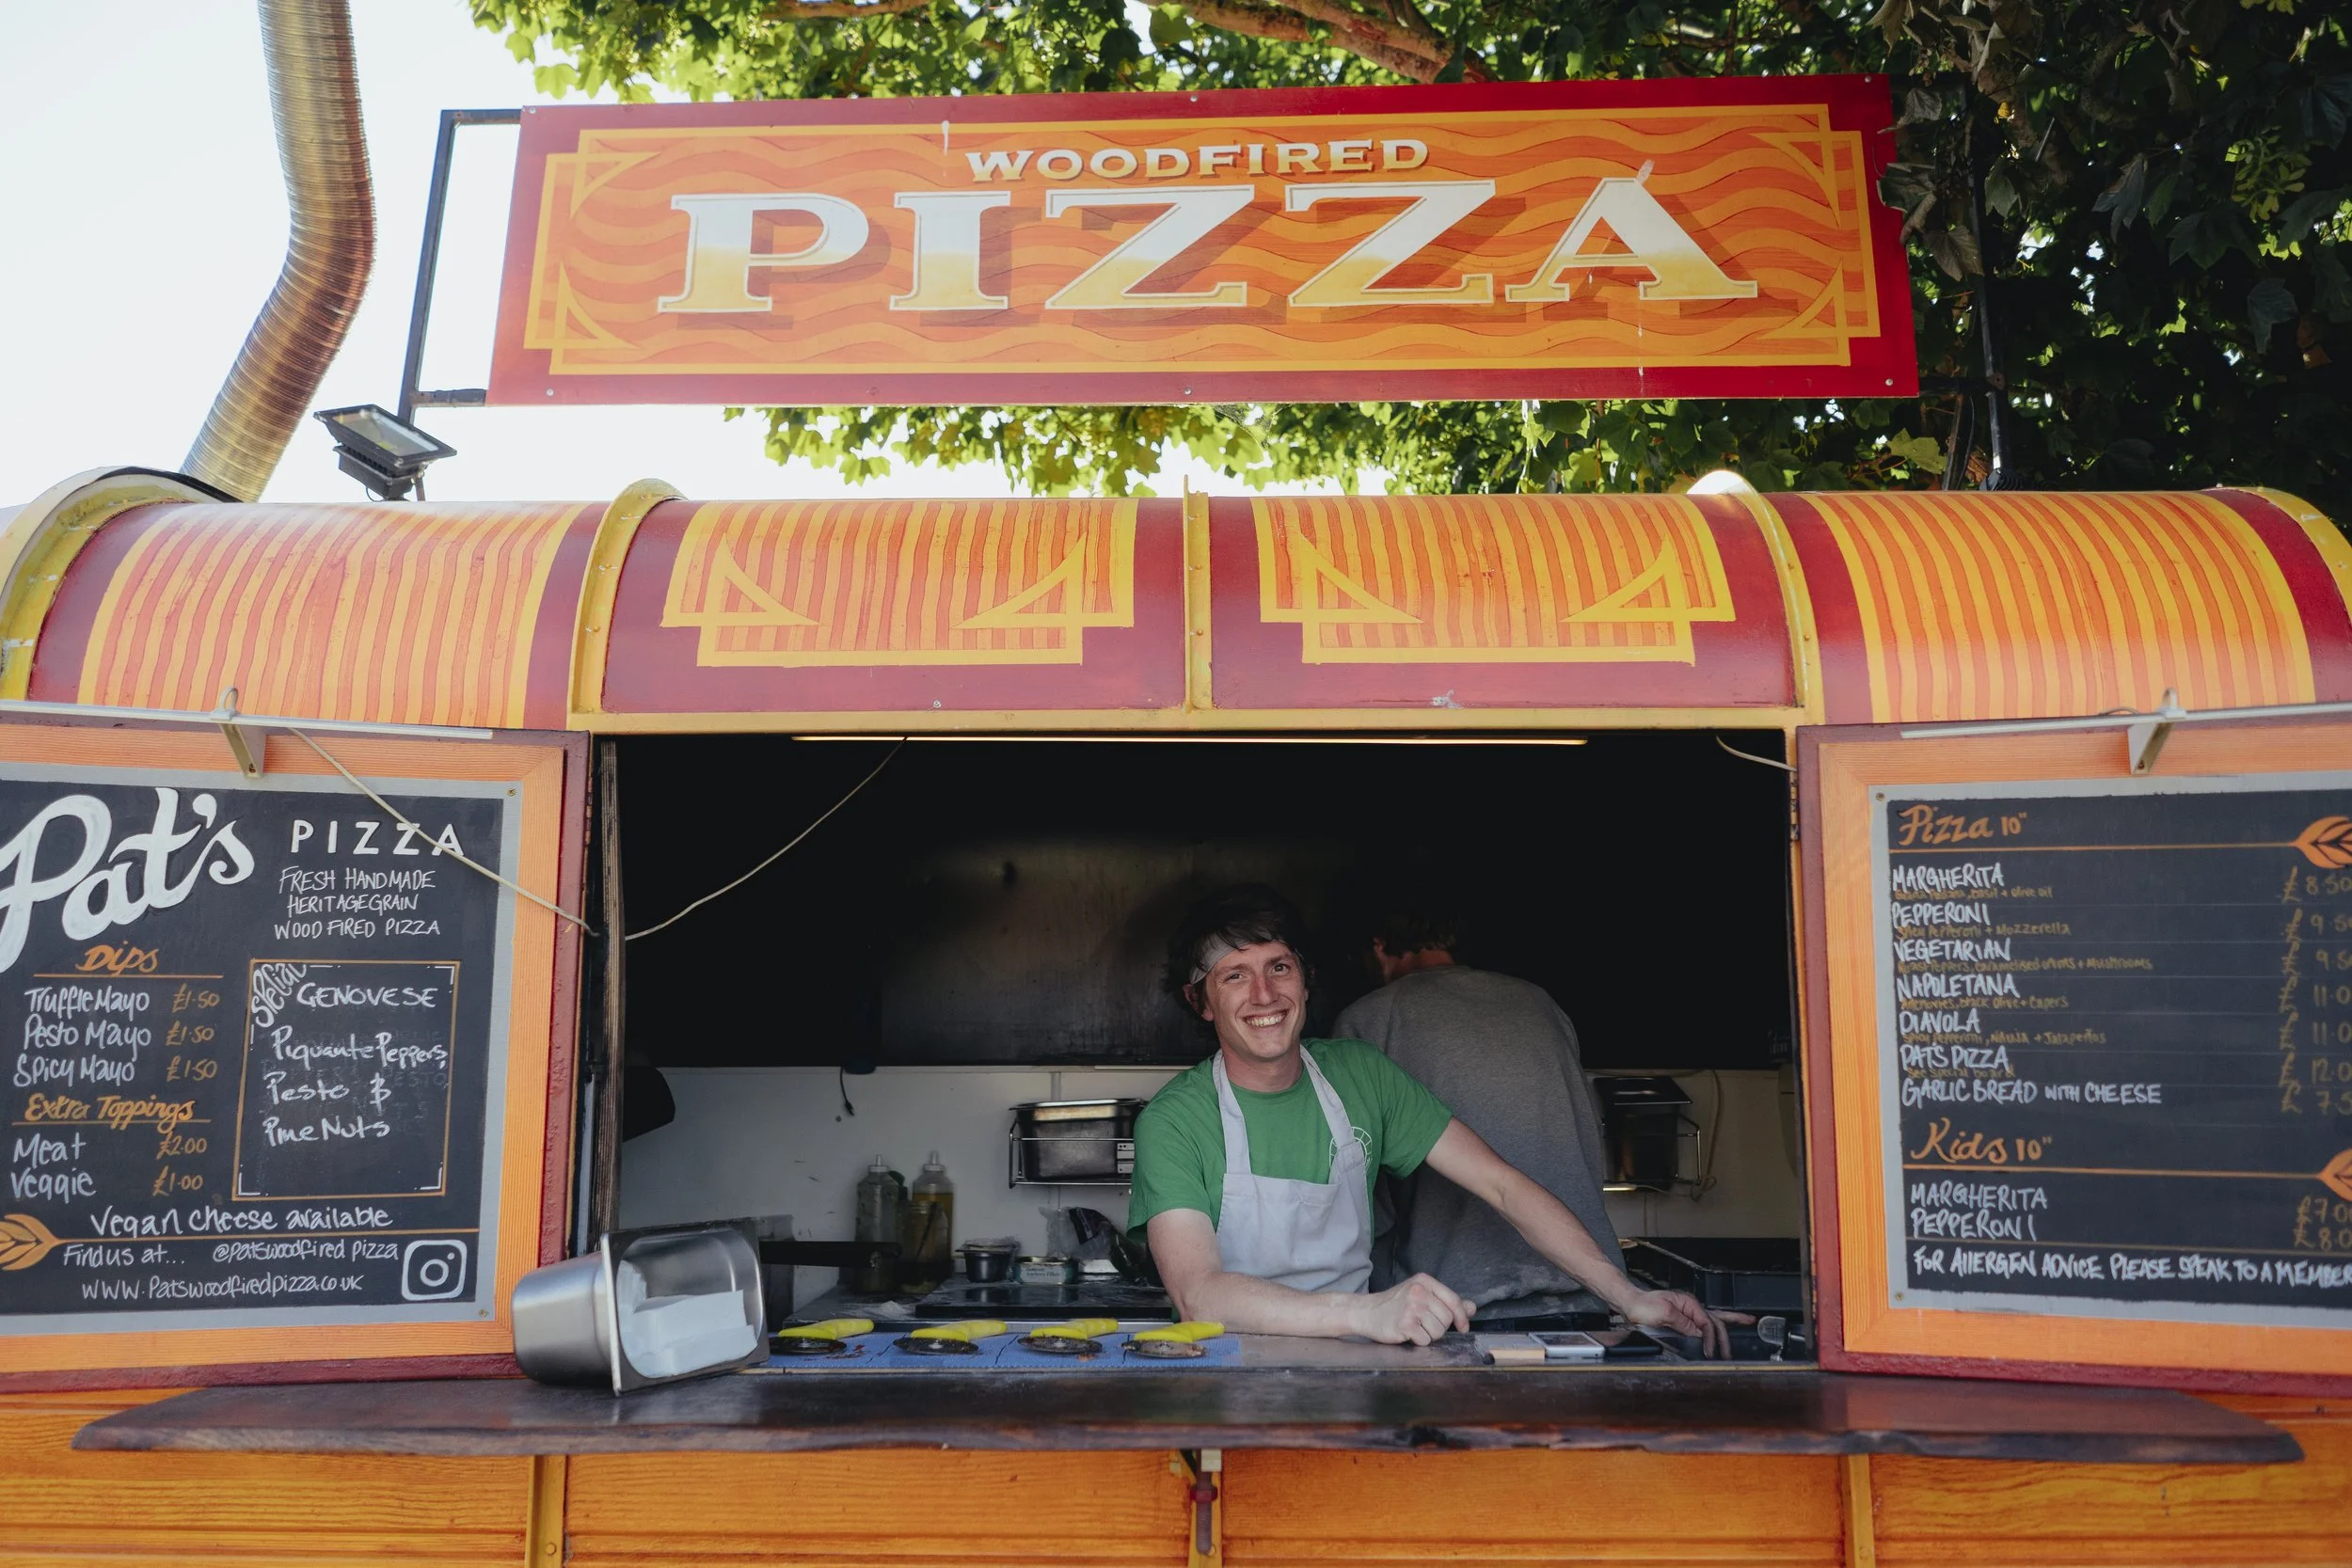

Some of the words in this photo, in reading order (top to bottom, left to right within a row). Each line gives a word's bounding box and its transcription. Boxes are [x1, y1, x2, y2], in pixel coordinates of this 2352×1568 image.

[964, 138, 1428, 183] WOODFIRED
[658, 178, 1757, 314] PIZZA
[291, 820, 464, 856] PIZZA
[1898, 804, 1994, 846] Pizza
[0, 787, 255, 973] Pat's
[279, 866, 335, 894] FRESH
[345, 867, 436, 892] HANDMADE
[1892, 862, 2005, 894] MARGHERITA
[386, 918, 440, 937] PIZZA
[1891, 901, 1991, 927] PEPPERONI
[75, 941, 159, 977] Dips
[1894, 938, 2010, 962] VEGETARIAN
[24, 987, 92, 1019] Truffle
[95, 986, 150, 1021] Mayo
[296, 983, 438, 1007] GENOVESE
[1896, 973, 2021, 1002] NAPOLETANA
[24, 1014, 79, 1050] Pesto
[86, 1020, 151, 1062] Mayo
[1898, 1009, 1980, 1035] DIAVOLA
[271, 1025, 373, 1070] Piquante
[1951, 1045, 2010, 1069] PIZZA
[13, 1053, 74, 1087] Spicy
[80, 1055, 135, 1086] Mayo
[263, 1071, 350, 1104] Pesto
[1901, 1077, 1971, 1108] GARLIC
[1973, 1079, 2038, 1104] BREAD
[2044, 1085, 2080, 1103] WITH
[2084, 1083, 2162, 1104] CHEESE
[24, 1092, 90, 1121] Extra
[97, 1095, 197, 1132] Toppings
[322, 1116, 390, 1141] Nuts
[13, 1132, 87, 1168] Meat
[1910, 1117, 2008, 1163] Kids
[10, 1167, 96, 1204] Veggie
[1910, 1180, 2048, 1212] MARGHERITA
[90, 1205, 183, 1238] Vegan
[285, 1207, 393, 1229] available
[1910, 1208, 2037, 1242] PEPPERONI
[1914, 1246, 1944, 1276] FOR
[2042, 1252, 2105, 1281] ADVICE
[2110, 1252, 2176, 1281] PLEASE
[2178, 1253, 2233, 1282] SPEAK
[2233, 1259, 2257, 1281] TO
[2260, 1260, 2273, 1283] A
